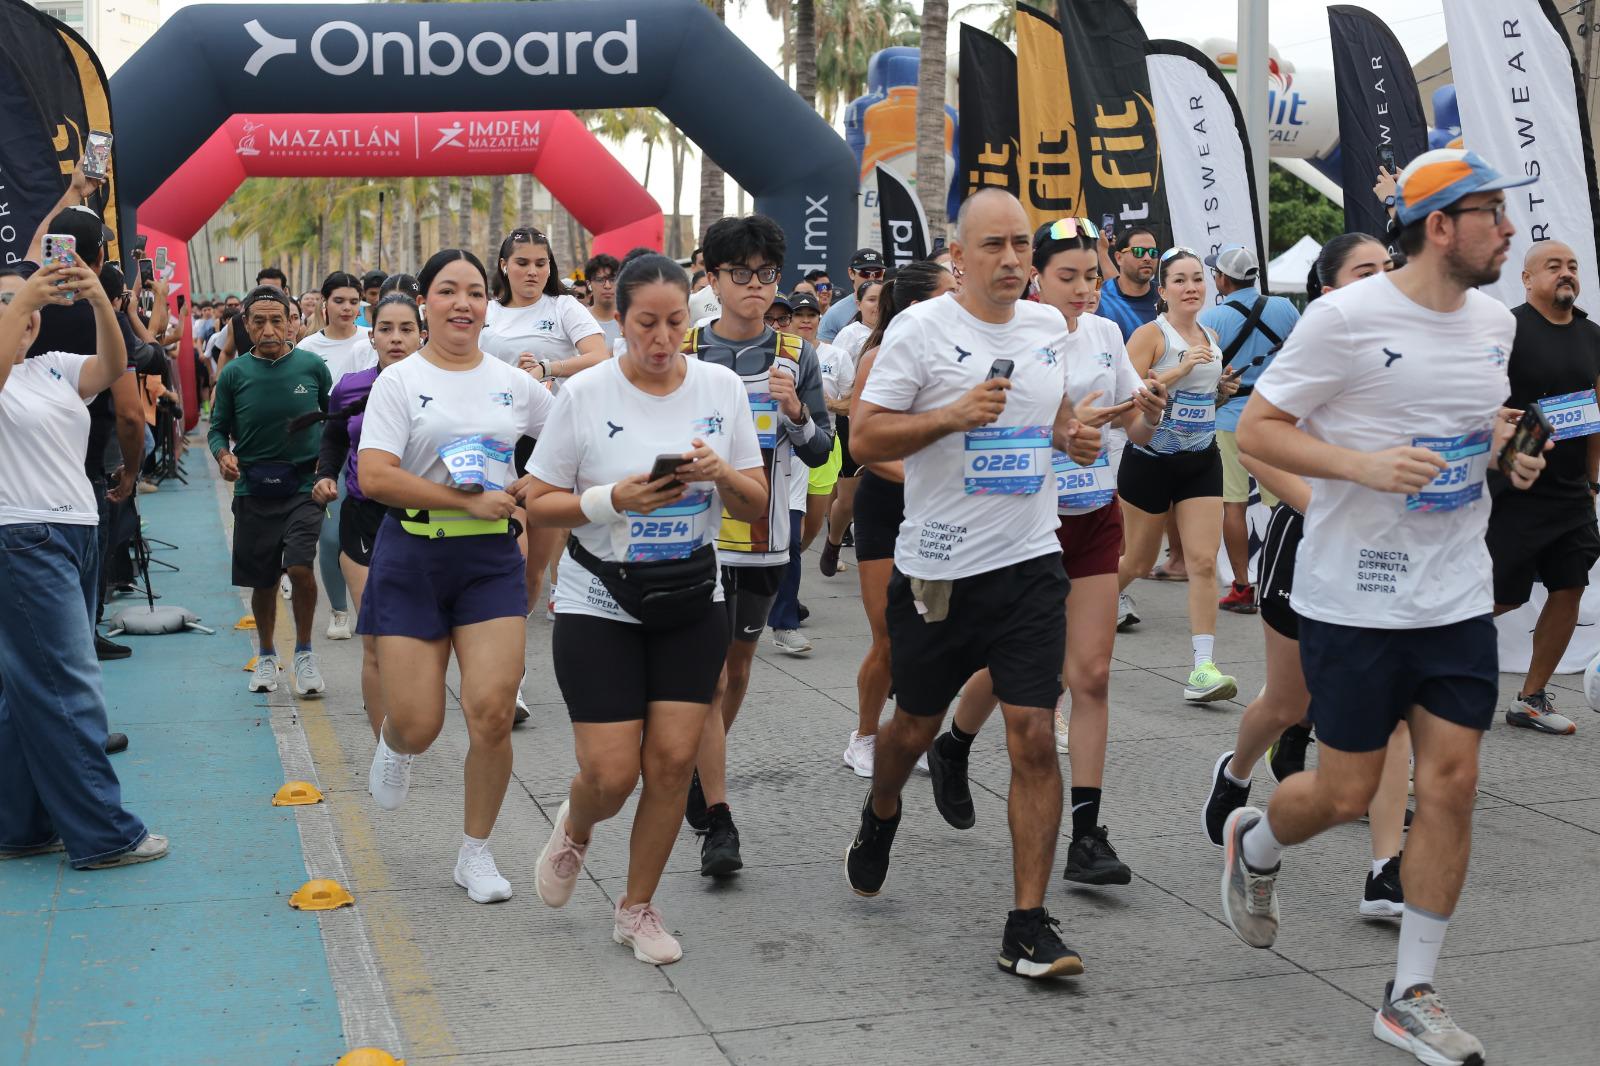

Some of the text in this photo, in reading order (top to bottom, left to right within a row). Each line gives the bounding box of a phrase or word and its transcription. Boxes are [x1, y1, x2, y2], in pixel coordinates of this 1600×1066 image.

[310, 19, 638, 76] Onboard
[268, 125, 400, 148] MAZATLÁN
[469, 120, 541, 137] IMDEM
[1503, 19, 1550, 243] RTSWEAR
[1090, 100, 1153, 189] fit
[968, 142, 1010, 197] it
[1028, 129, 1072, 210] fit
[1177, 407, 1207, 419] 0193
[971, 453, 1031, 472] 0226
[1055, 472, 1095, 491] 0263
[631, 521, 689, 538] 0254
[924, 520, 968, 535] CONECTA
[921, 529, 963, 544] DISFRUTA
[919, 538, 952, 552] SUPERA
[1359, 548, 1409, 562] CONECTA
[1358, 559, 1408, 573] DISFRUTA
[1357, 571, 1397, 583] SUPERA
[588, 586, 613, 599] DISFR
[1356, 582, 1397, 594] INSPIRA
[586, 595, 620, 611] SUPERA
